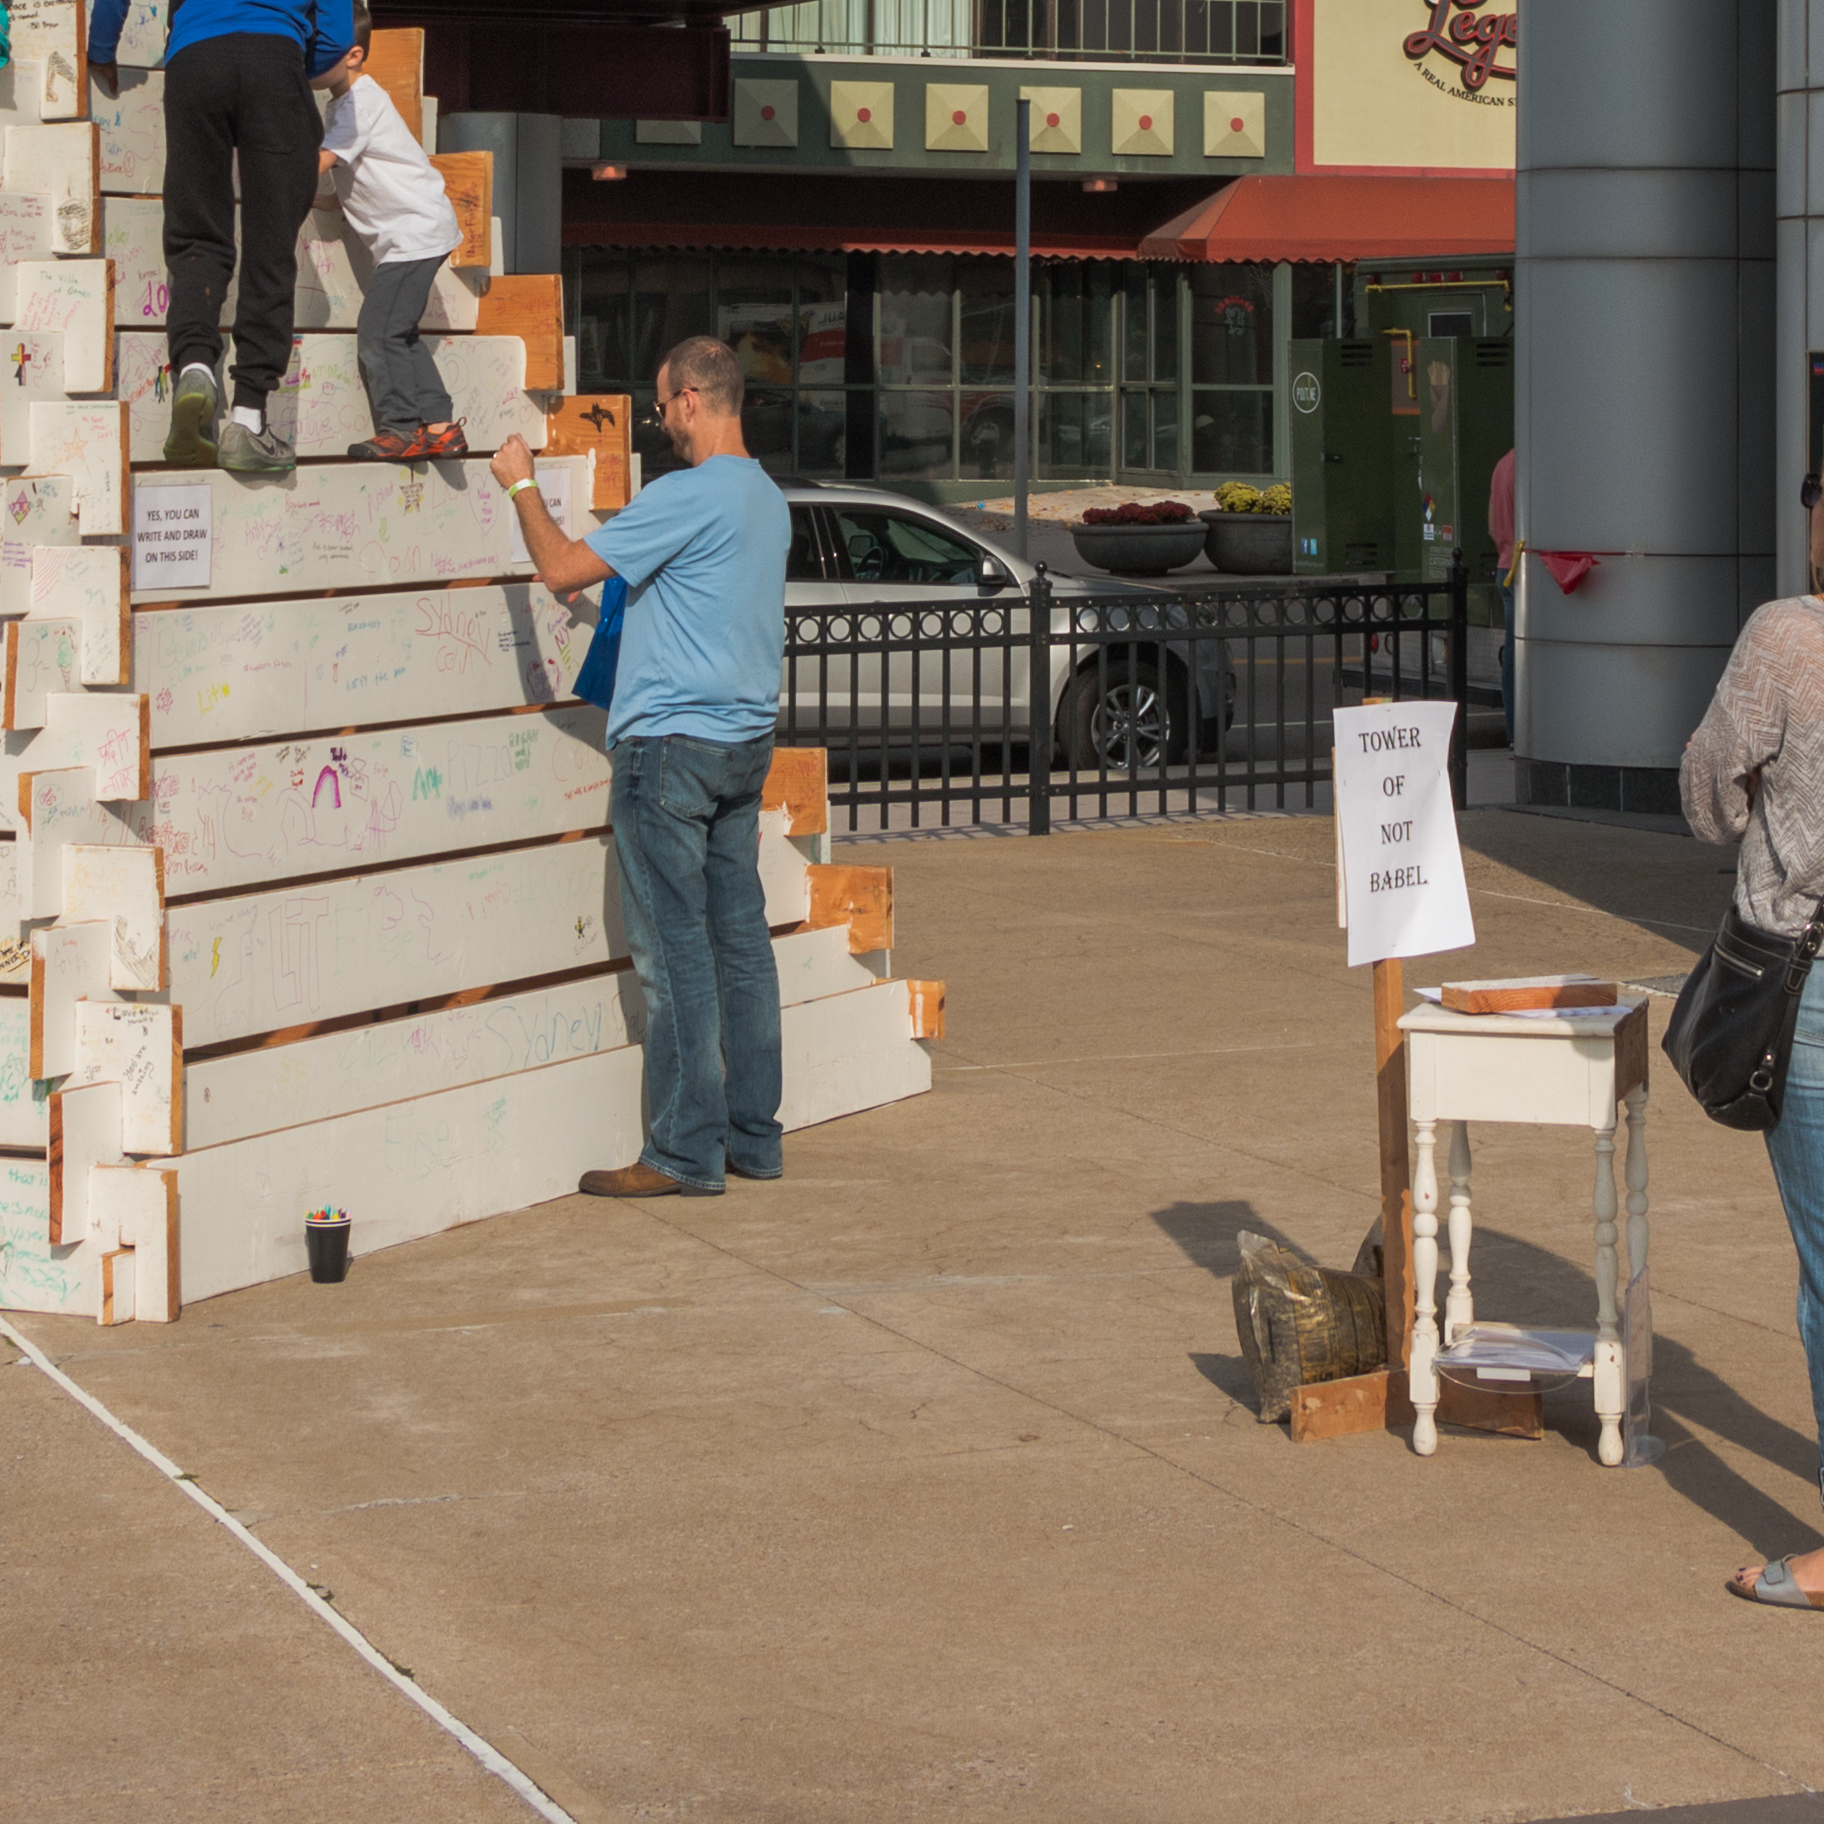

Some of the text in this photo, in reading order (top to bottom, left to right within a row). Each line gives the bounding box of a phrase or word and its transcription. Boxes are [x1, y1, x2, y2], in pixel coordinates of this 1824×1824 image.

[1414, 62, 1517, 107] A REAL AMERICAN S
[550, 498, 562, 508] CAN
[147, 508, 200, 521] YES, YOU CAN
[552, 514, 564, 526] IS!
[137, 528, 207, 542] WRITE AND DRAW
[145, 550, 198, 563] ON THIS SIDE!
[1358, 725, 1422, 753] TOWER
[1382, 775, 1406, 797] OF
[1380, 821, 1414, 845] NOT
[1369, 865, 1429, 894] BABEL
